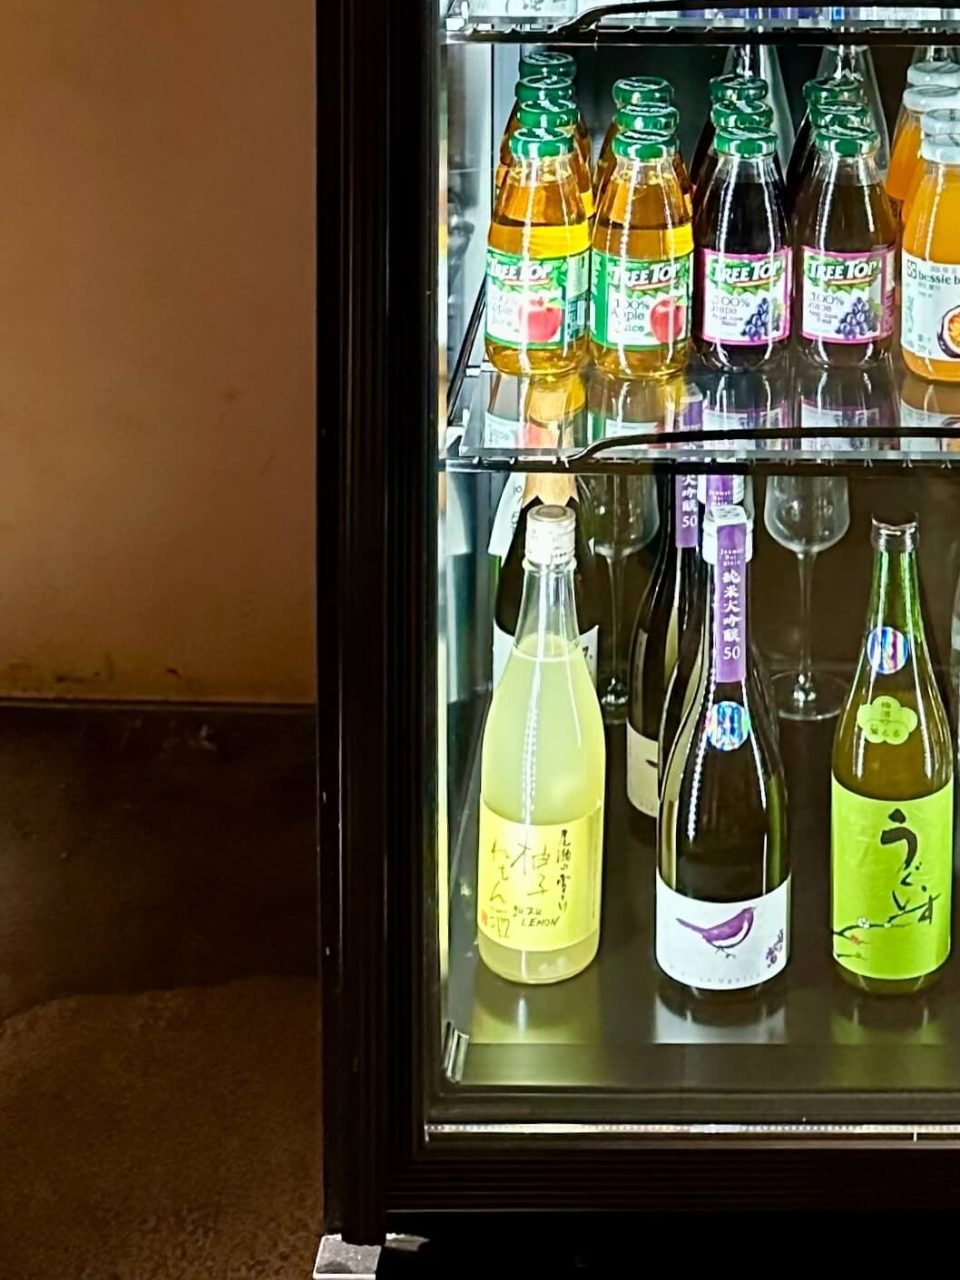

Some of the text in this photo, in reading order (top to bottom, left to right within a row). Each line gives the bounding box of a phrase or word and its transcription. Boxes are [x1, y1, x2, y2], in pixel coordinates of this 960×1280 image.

[713, 259, 782, 282] TREE TOP
[808, 259, 877, 280] TREE TOP
[682, 515, 698, 528] 50
[722, 569, 742, 643] 純米大吟醸
[723, 646, 741, 660] 50
[521, 916, 560, 928] LEMON
